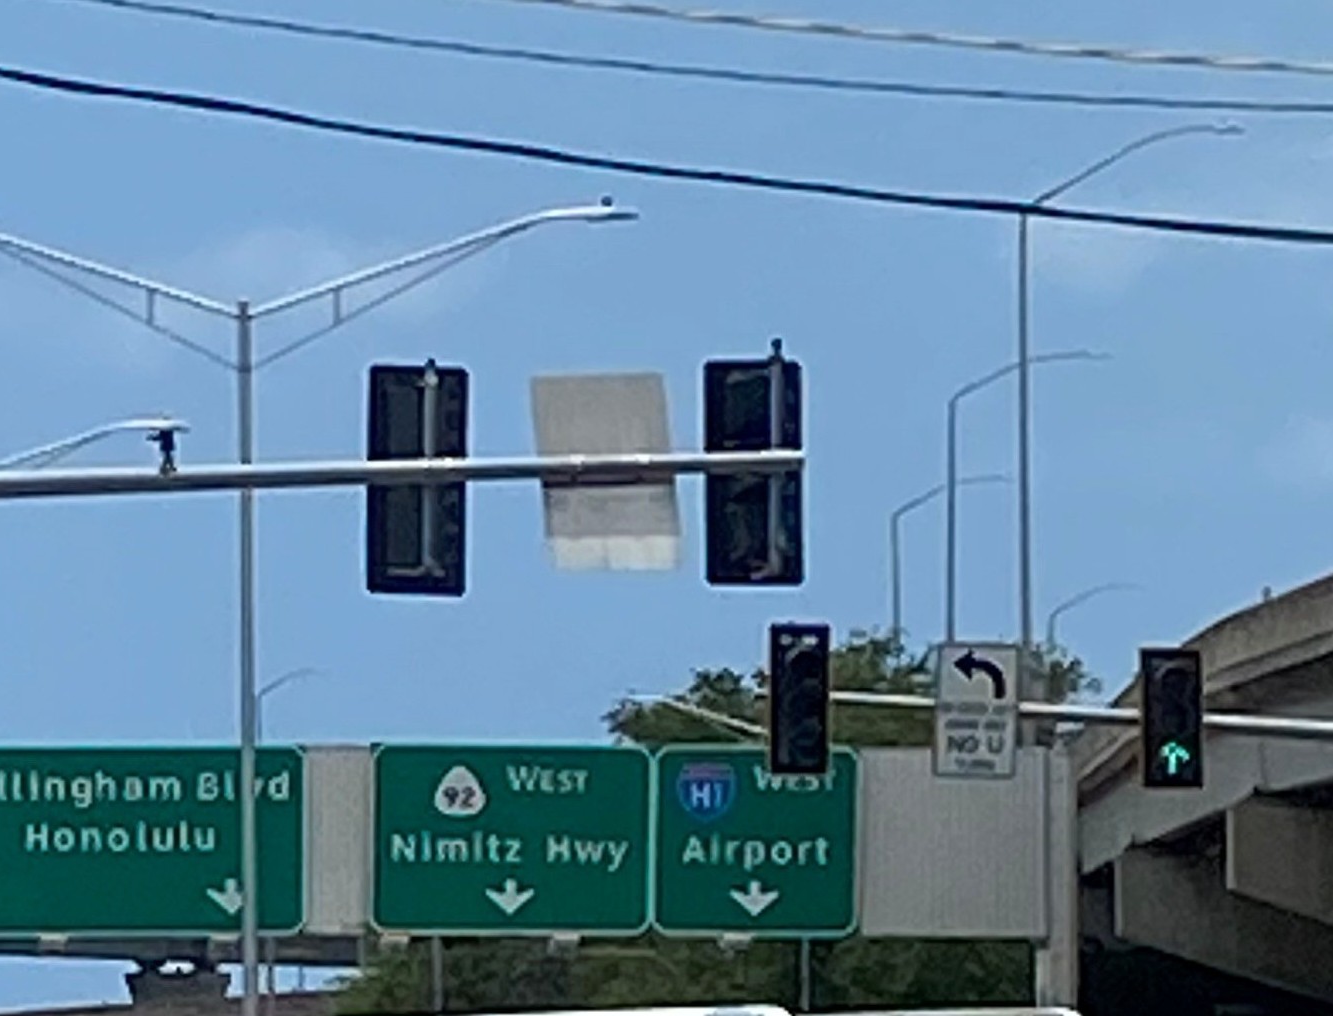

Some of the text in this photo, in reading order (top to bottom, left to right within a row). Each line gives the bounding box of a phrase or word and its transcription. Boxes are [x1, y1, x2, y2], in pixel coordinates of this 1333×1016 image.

[506, 765, 589, 793] WEST
[753, 765, 836, 792] WEST
[442, 787, 476, 809] 92
[25, 821, 216, 852] Honolulu
[390, 831, 629, 871] Nimitz Hwy
[682, 835, 830, 869] Airport
